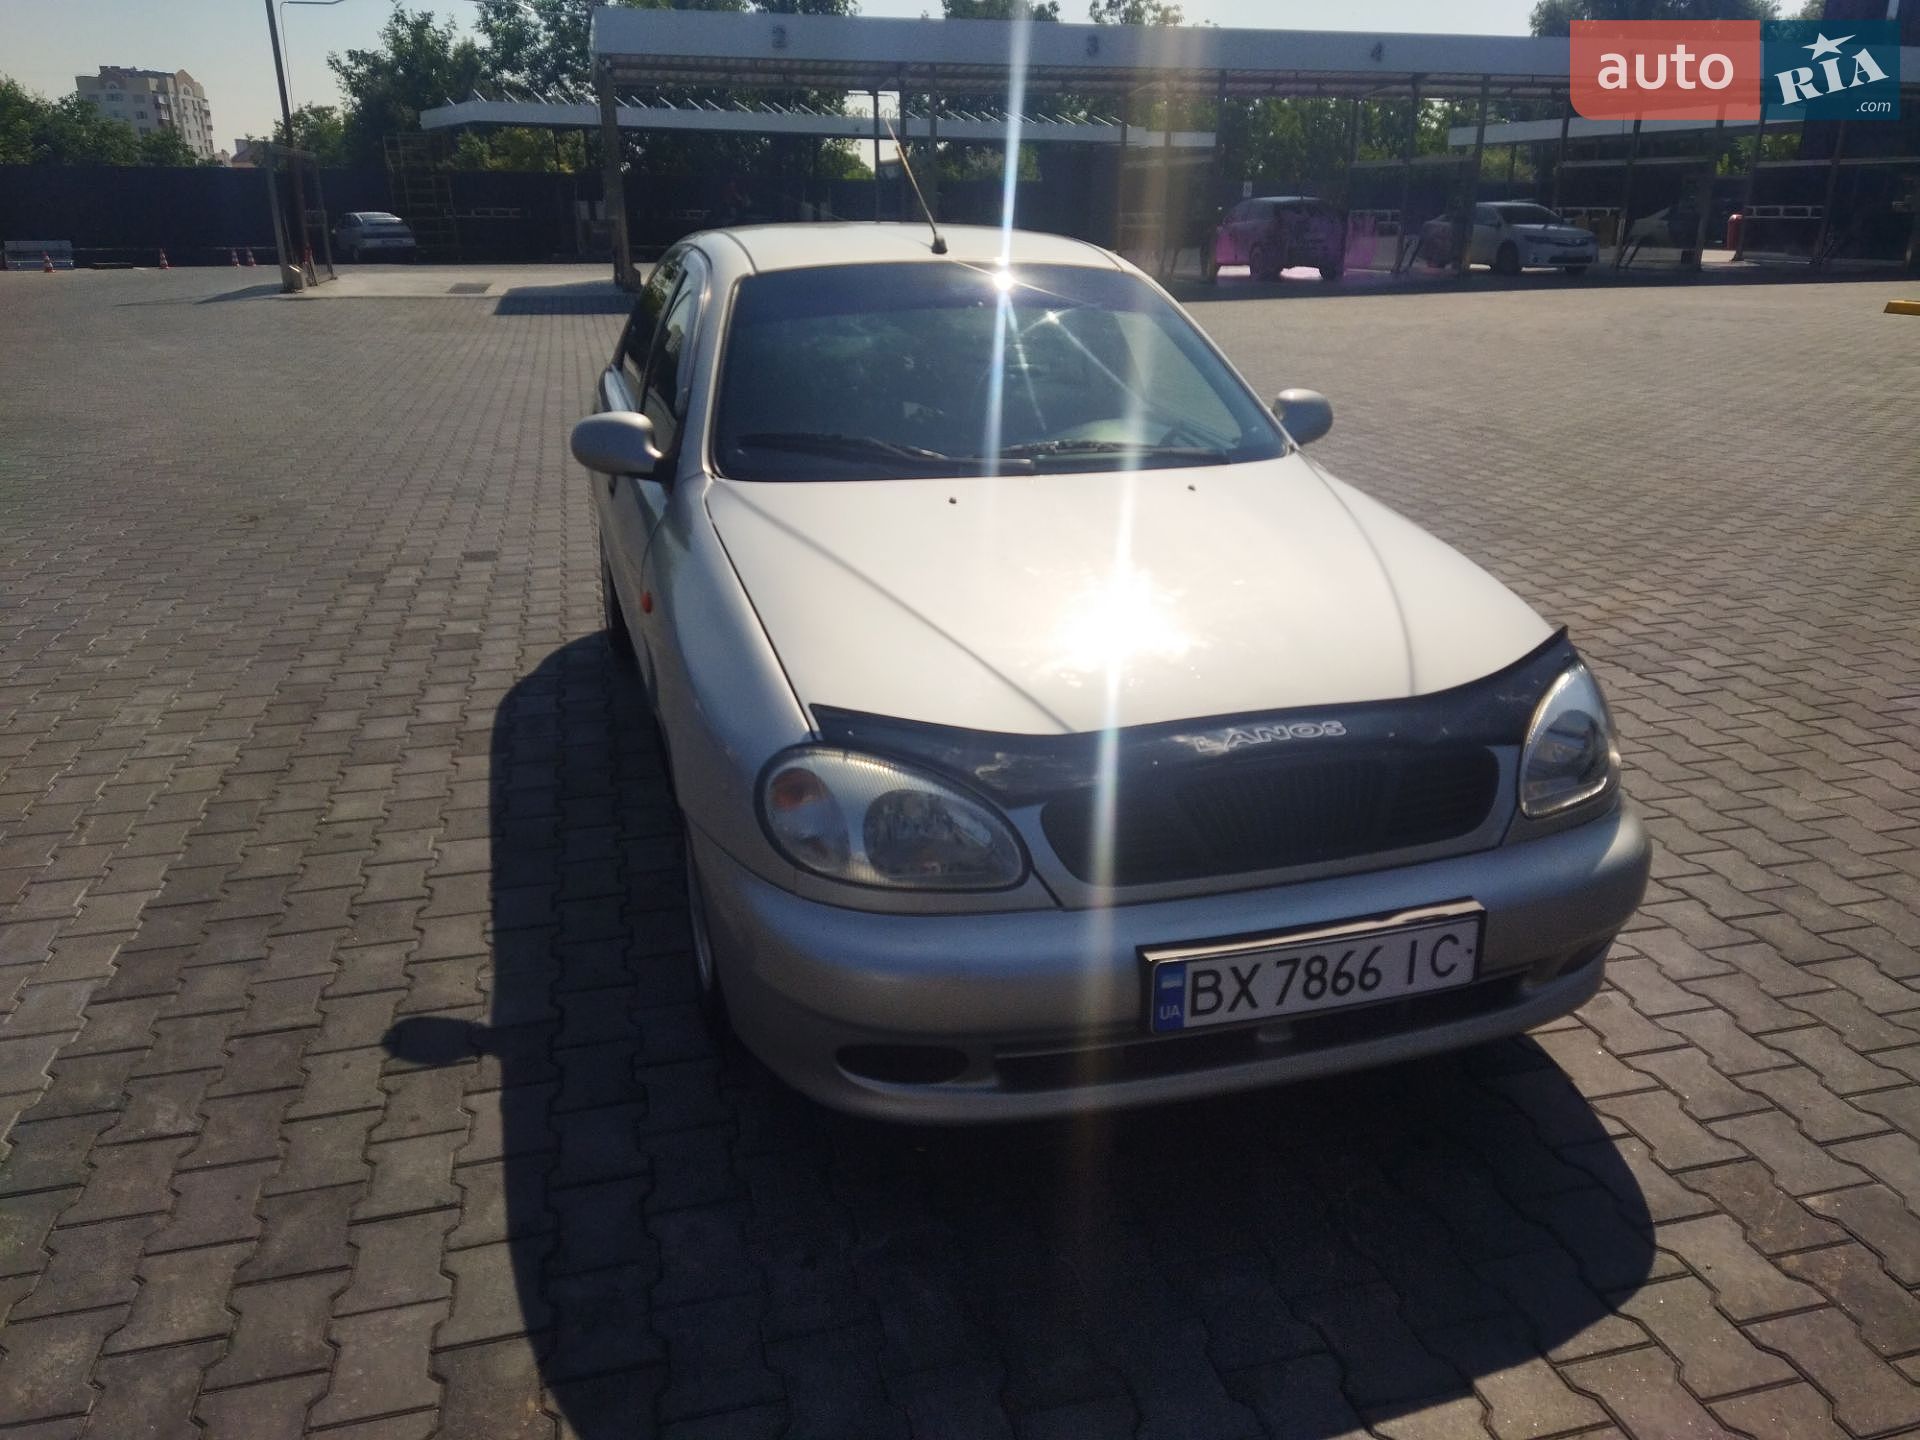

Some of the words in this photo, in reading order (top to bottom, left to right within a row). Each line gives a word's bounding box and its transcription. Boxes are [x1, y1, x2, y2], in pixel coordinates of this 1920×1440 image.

[1193, 720, 1347, 754] LANOS
[1190, 963, 1262, 1017] BX
[1276, 945, 1384, 1007] 7866
[1407, 933, 1460, 985] IC
[1160, 1004, 1182, 1020] UA
